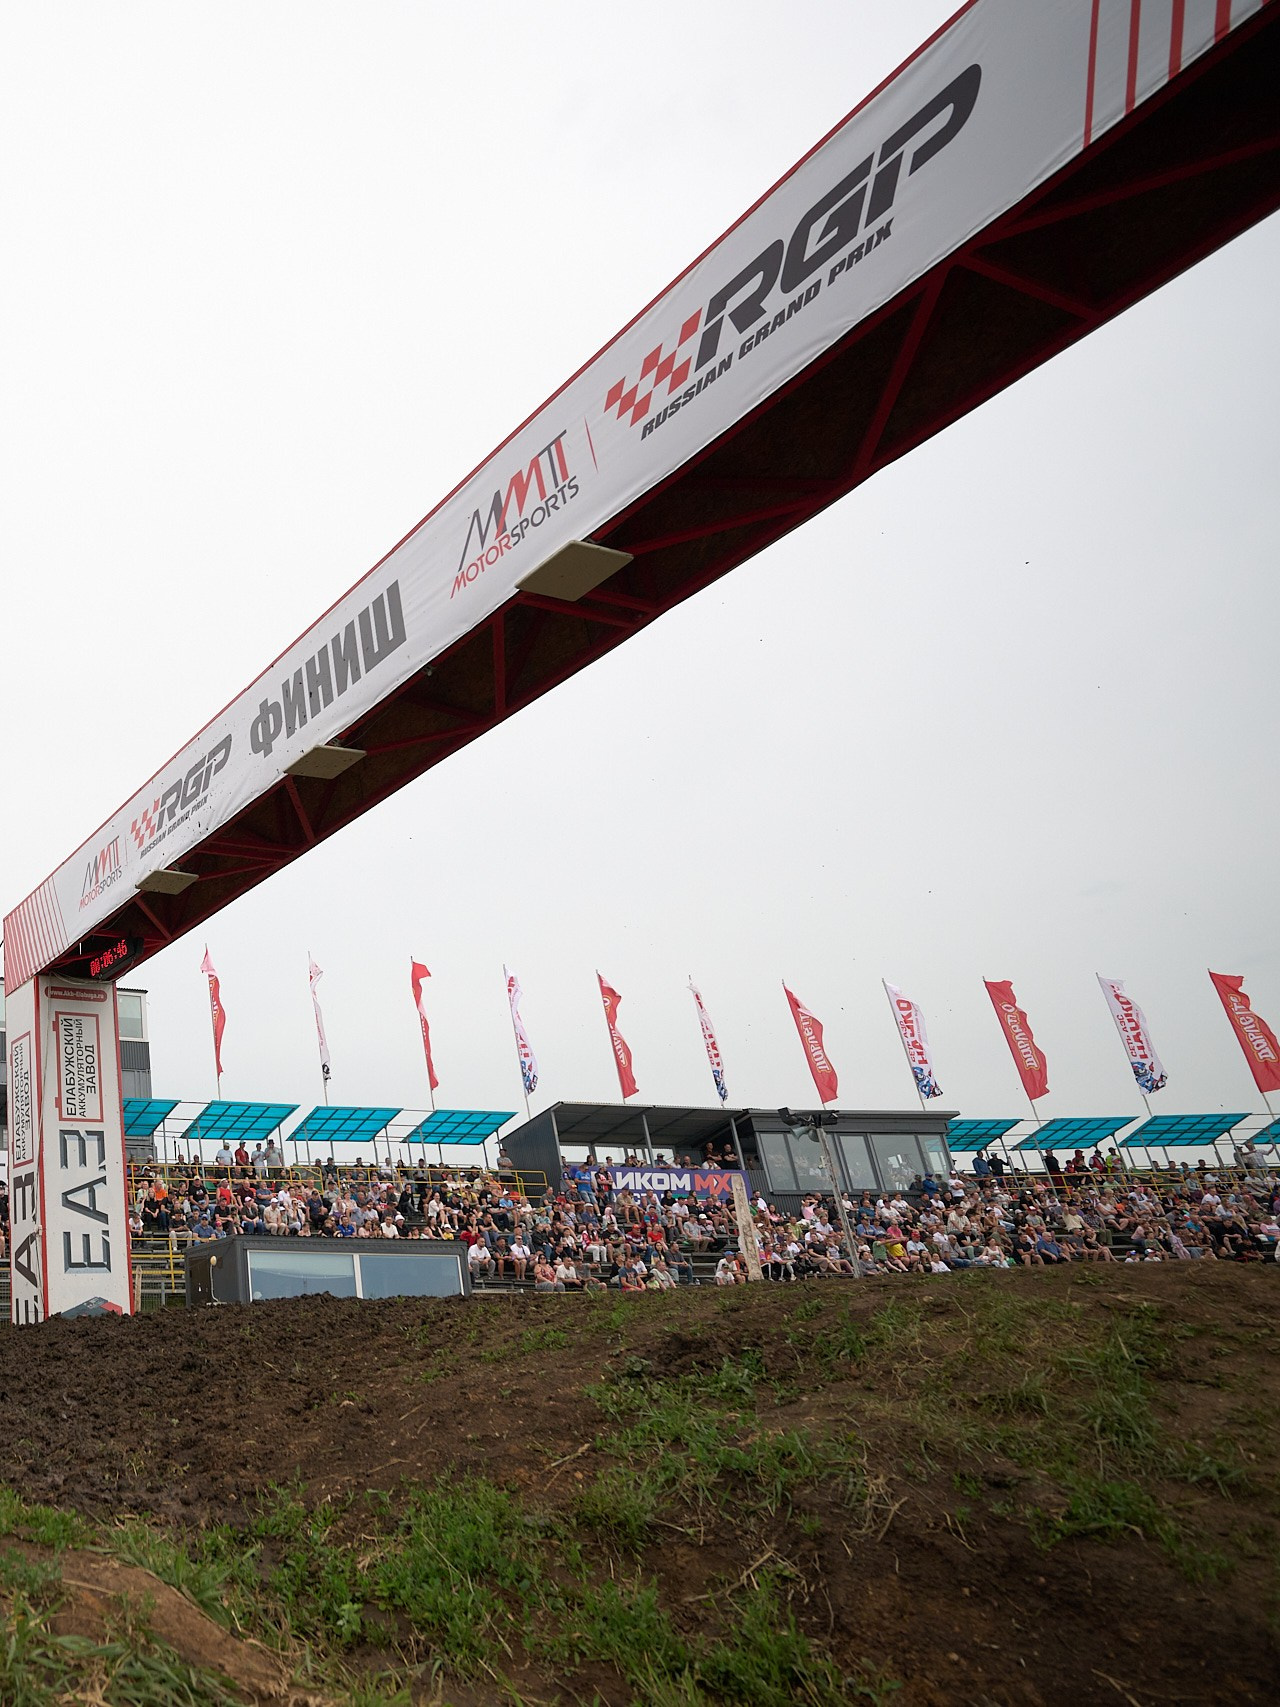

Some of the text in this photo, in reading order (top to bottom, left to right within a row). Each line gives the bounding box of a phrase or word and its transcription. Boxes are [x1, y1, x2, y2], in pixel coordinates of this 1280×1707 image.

[694, 63, 982, 373] RGP
[641, 216, 895, 441] RUSSIAN GRAND PRIX
[450, 475, 579, 599] MOTORSPORTS
[249, 579, 407, 758] ФИНИШ
[156, 733, 232, 833] RGP
[79, 865, 123, 912] MOTORSPORTS
[140, 831, 167, 859] RUSSIAN
[61, 1018, 77, 1117] ЕЛАБУЖСКИЙ
[74, 1018, 87, 1118] АККУМУЛЯТОРНЫЙ
[85, 1044, 97, 1094] ЗАВОД
[59, 1128, 112, 1274] ЕАЗ
